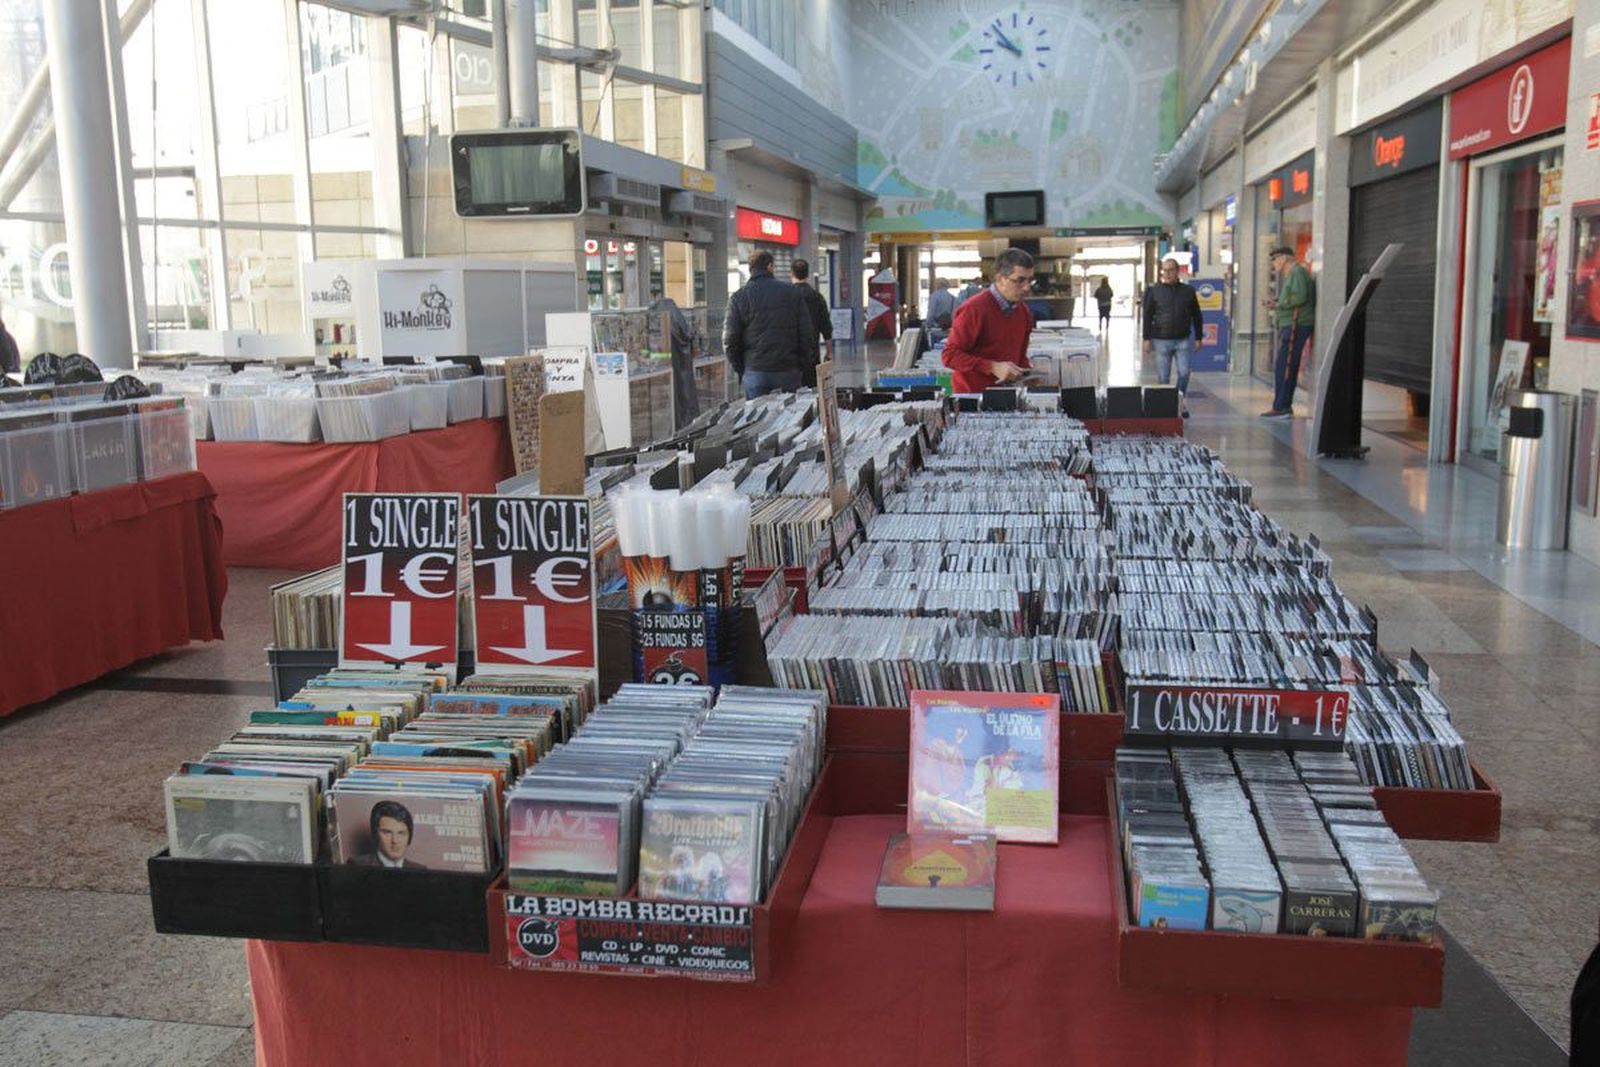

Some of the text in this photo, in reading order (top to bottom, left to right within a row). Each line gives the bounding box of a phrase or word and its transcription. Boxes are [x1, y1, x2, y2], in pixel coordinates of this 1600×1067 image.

[1376, 135, 1405, 167] Orange
[544, 357, 579, 365] OMPRA
[347, 497, 457, 548] 1 SINGLE
[471, 499, 589, 552] 1 SINGLE
[347, 552, 456, 599] 1€
[474, 555, 590, 604] 1€
[642, 614, 703, 628] 15 FUNDAS LP
[643, 633, 704, 647] 25 FUNDAS SG
[986, 713, 998, 724] EL
[1130, 690, 1140, 730] 1
[1154, 690, 1280, 735] CASSETTE
[993, 724, 1005, 736] DE
[1007, 725, 1020, 737] LA
[525, 808, 602, 839] MAZE
[1308, 894, 1333, 906] JOSÉ
[507, 895, 749, 925] LA BOMBA RECORDS
[1290, 906, 1351, 918] CARRERAS
[522, 932, 554, 945] DVD
[602, 940, 726, 957] CD LP DVD COMIC
[581, 951, 750, 971] REVISTAS CINE VIDEOJUEGOS
